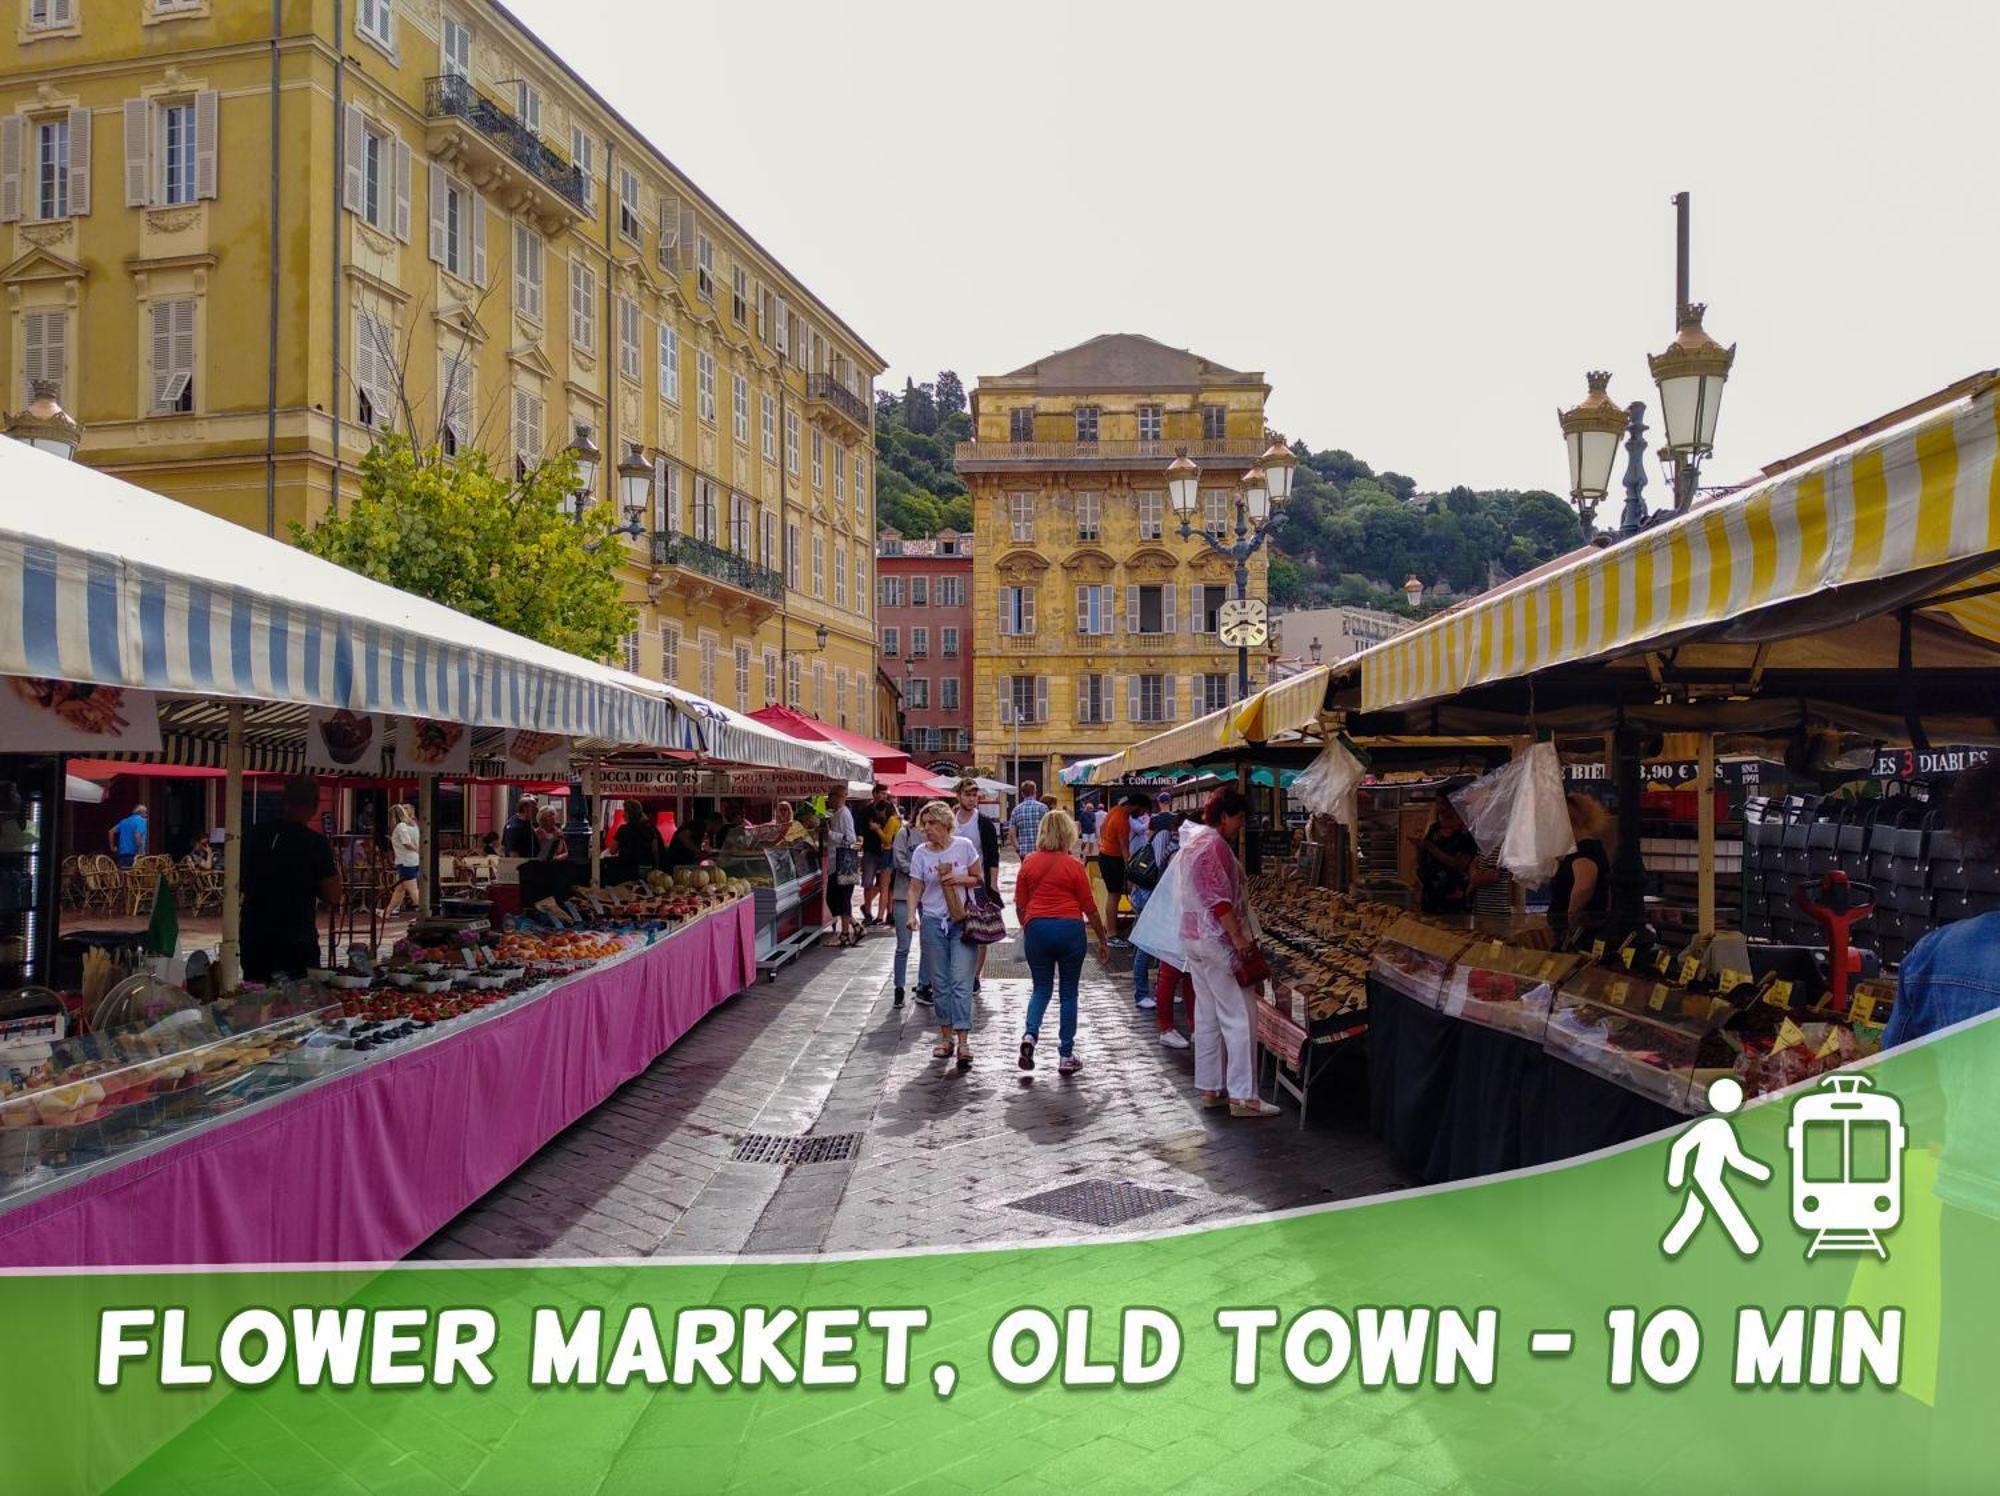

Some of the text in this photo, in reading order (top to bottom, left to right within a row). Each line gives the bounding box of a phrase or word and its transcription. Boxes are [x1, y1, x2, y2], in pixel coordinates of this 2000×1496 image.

[1741, 764, 1760, 773] SINCE
[1900, 749, 1914, 778] 3
[1919, 751, 1989, 772] DIABLES
[599, 771, 631, 783] OCCA
[632, 772, 653, 783] DU
[1128, 776, 1178, 786] CONTAINER
[1742, 774, 1760, 784] 1991
